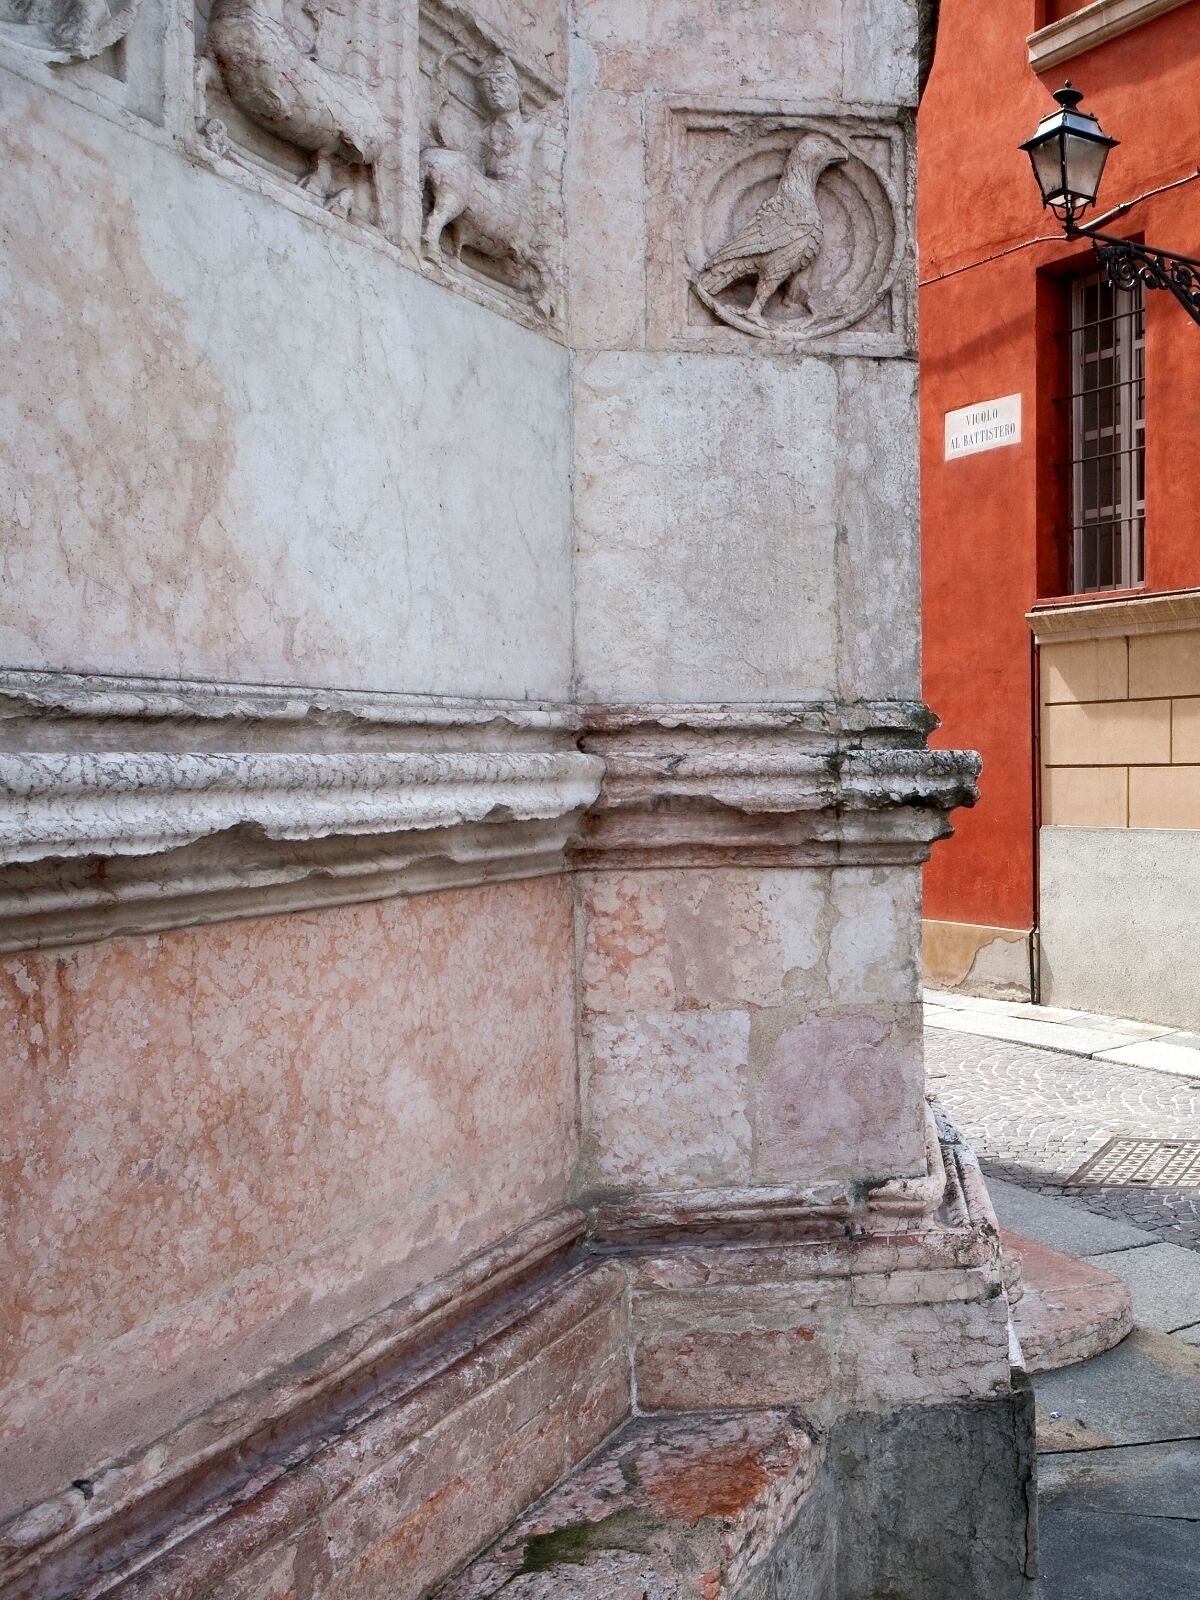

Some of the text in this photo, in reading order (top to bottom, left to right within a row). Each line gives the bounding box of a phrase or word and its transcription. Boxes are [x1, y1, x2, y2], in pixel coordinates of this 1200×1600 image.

[966, 408, 998, 426] VICOLO
[951, 422, 1016, 450] AL BATTISTERO
